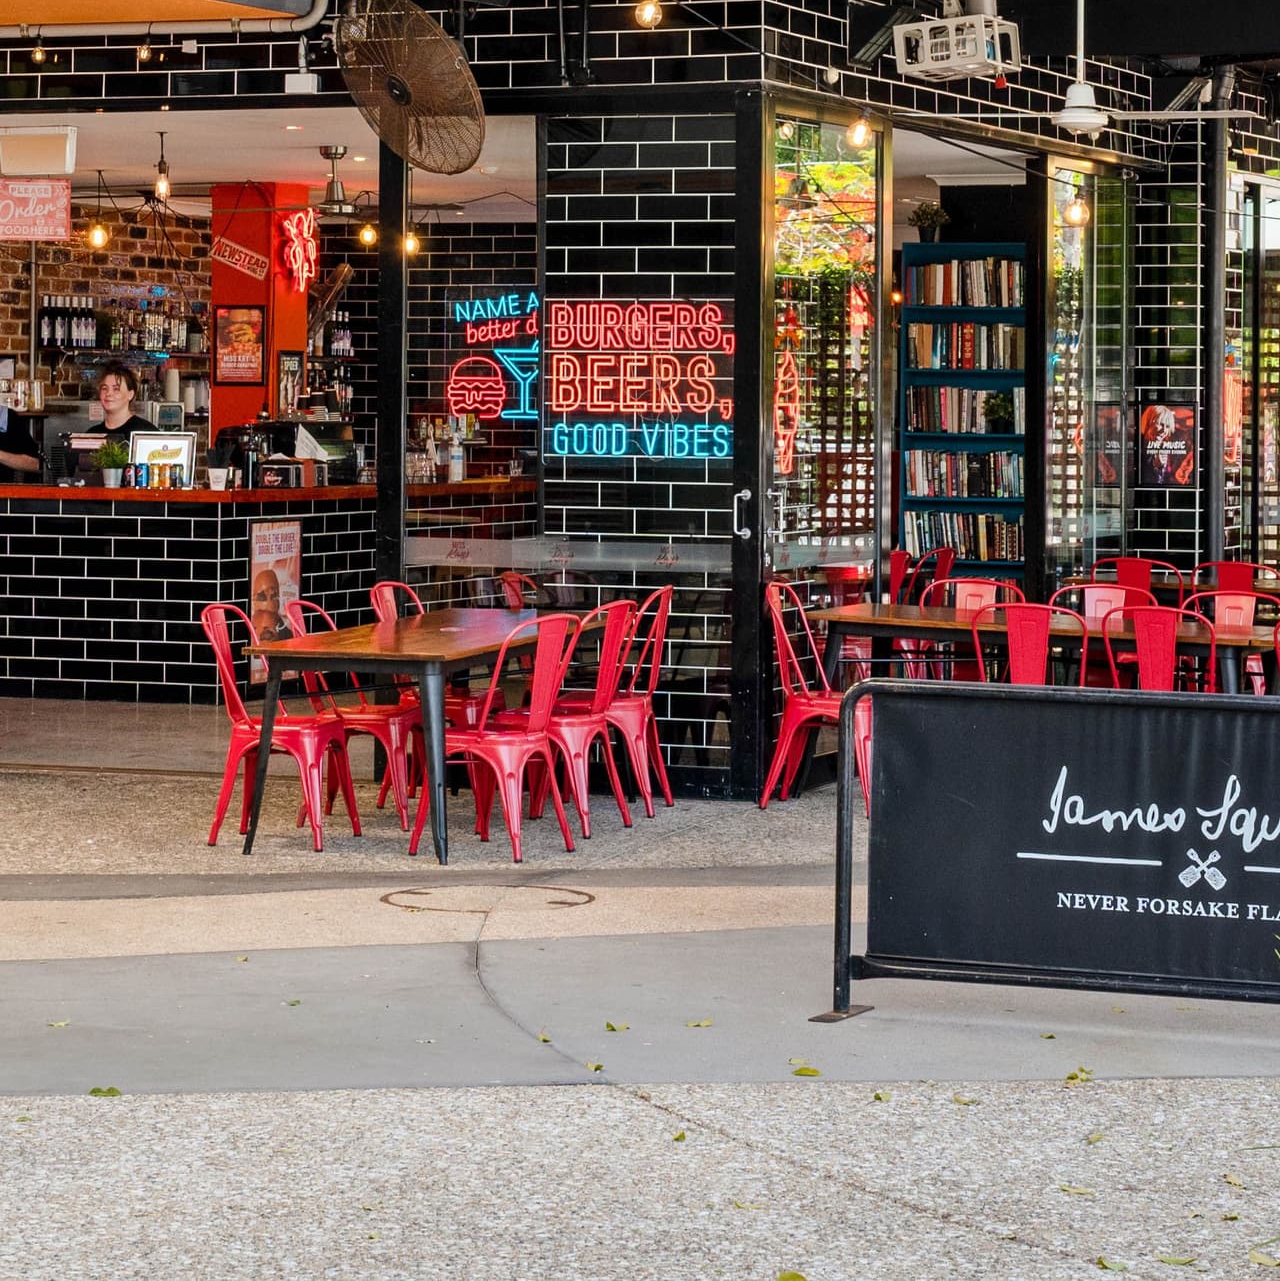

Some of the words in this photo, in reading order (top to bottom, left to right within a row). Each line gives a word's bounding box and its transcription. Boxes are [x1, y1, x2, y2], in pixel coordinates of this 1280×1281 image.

[0, 225, 29, 235] FOOD
[31, 225, 55, 235] HERE
[214, 238, 268, 270] NEWSTEAD
[454, 294, 520, 323] NAME
[465, 317, 521, 344] better
[549, 303, 736, 355] BURGERS,
[551, 354, 734, 421] BEERS,
[552, 422, 628, 457] GOOD
[642, 422, 731, 458] VIBES
[1042, 765, 1186, 834] James
[1056, 891, 1131, 913] NEVER
[1136, 896, 1240, 920] FORSAKE
